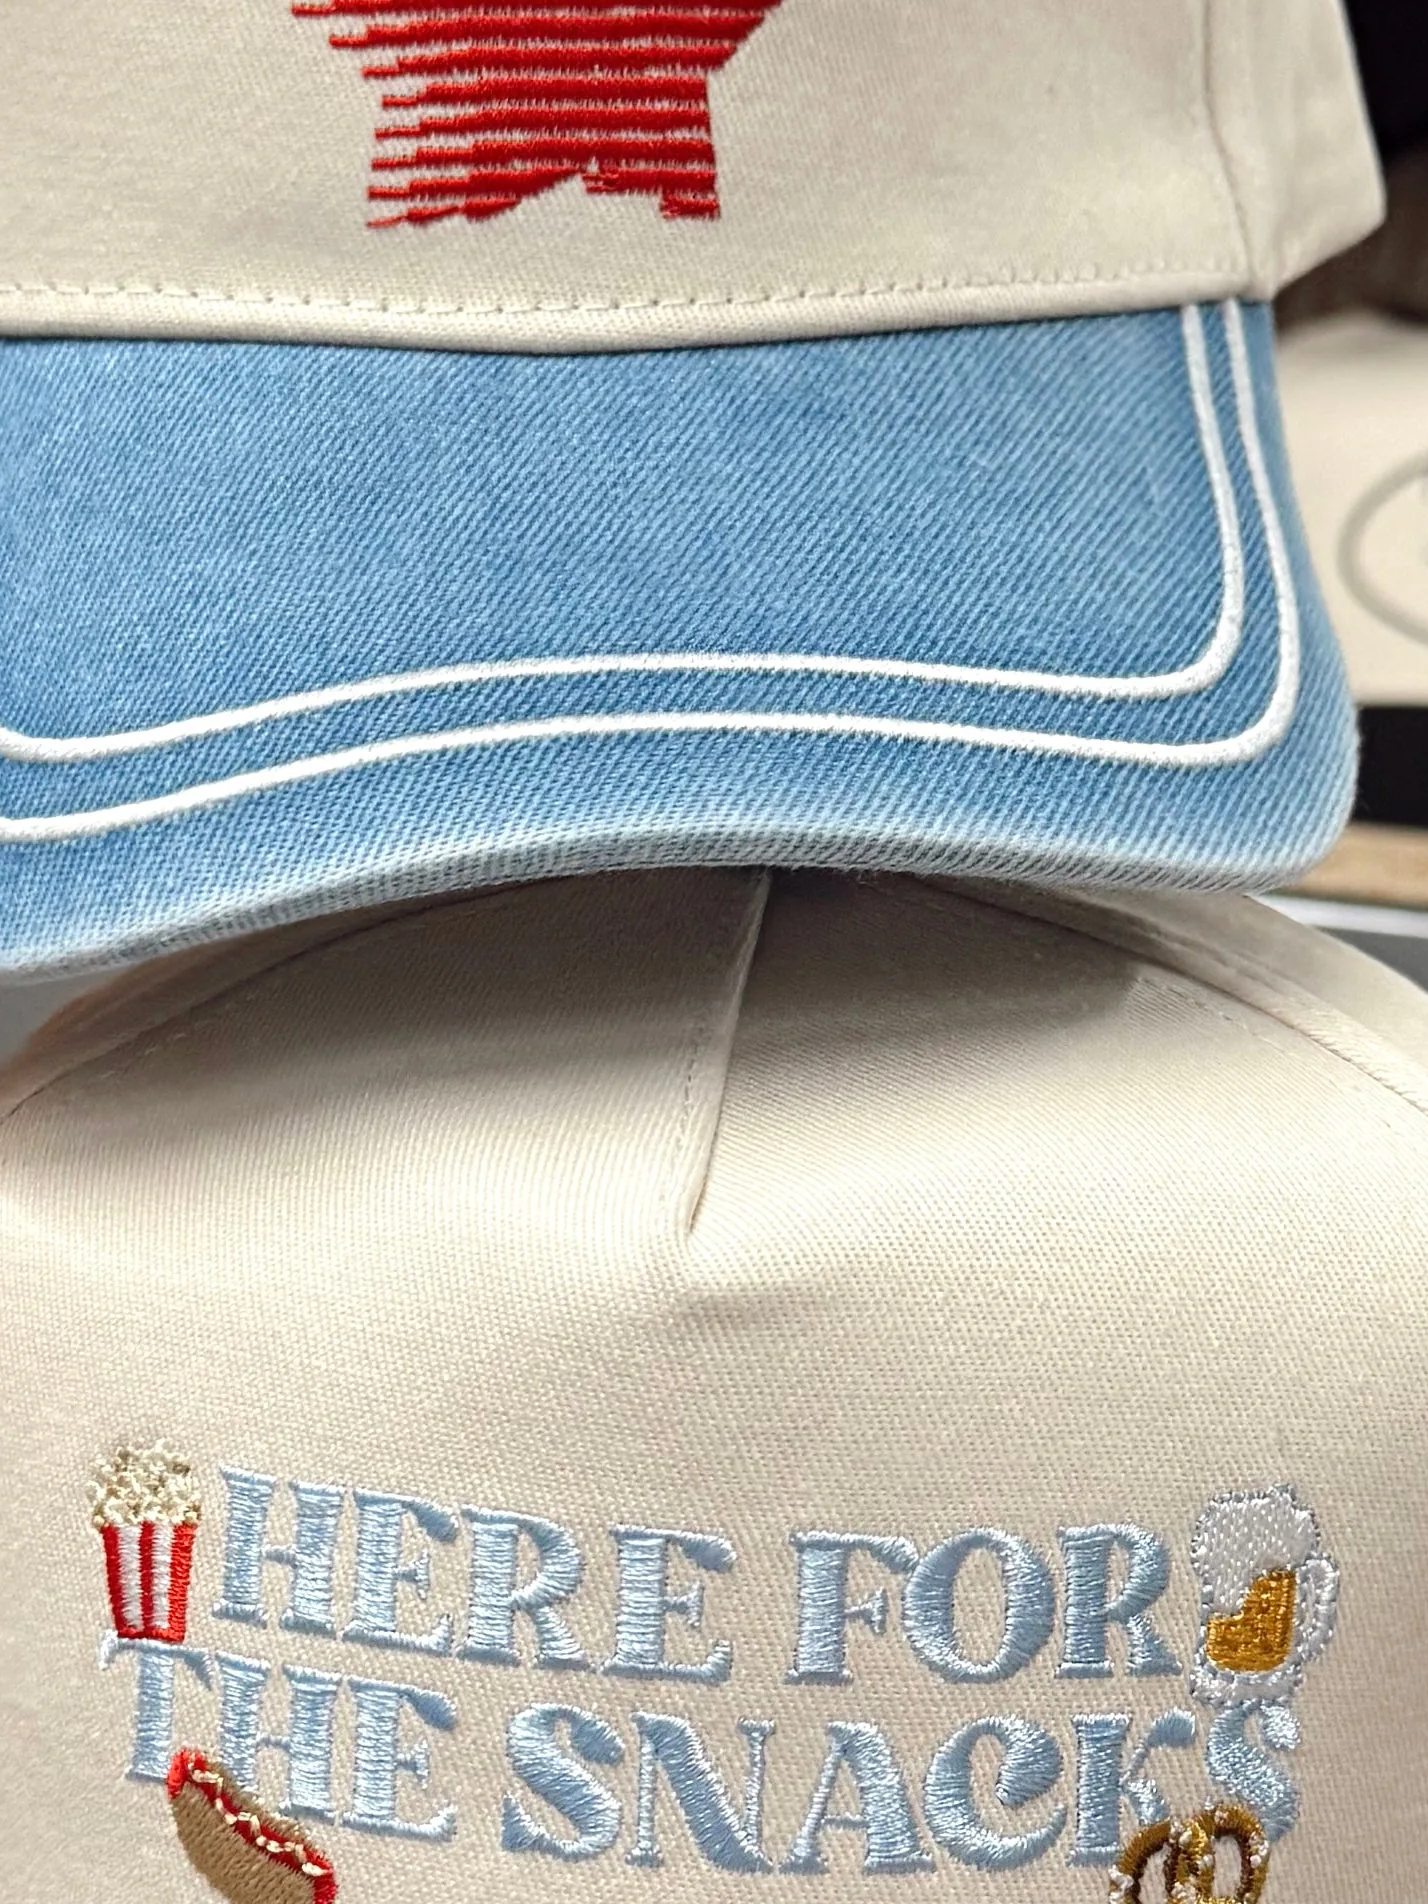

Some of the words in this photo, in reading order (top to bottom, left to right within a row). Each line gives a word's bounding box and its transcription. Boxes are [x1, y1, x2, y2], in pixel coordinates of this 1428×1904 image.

[211, 1464, 738, 1686] HERE
[782, 1522, 1182, 1686] FOR
[99, 1628, 460, 1842] THE
[498, 1693, 1304, 1875] SNACKS
